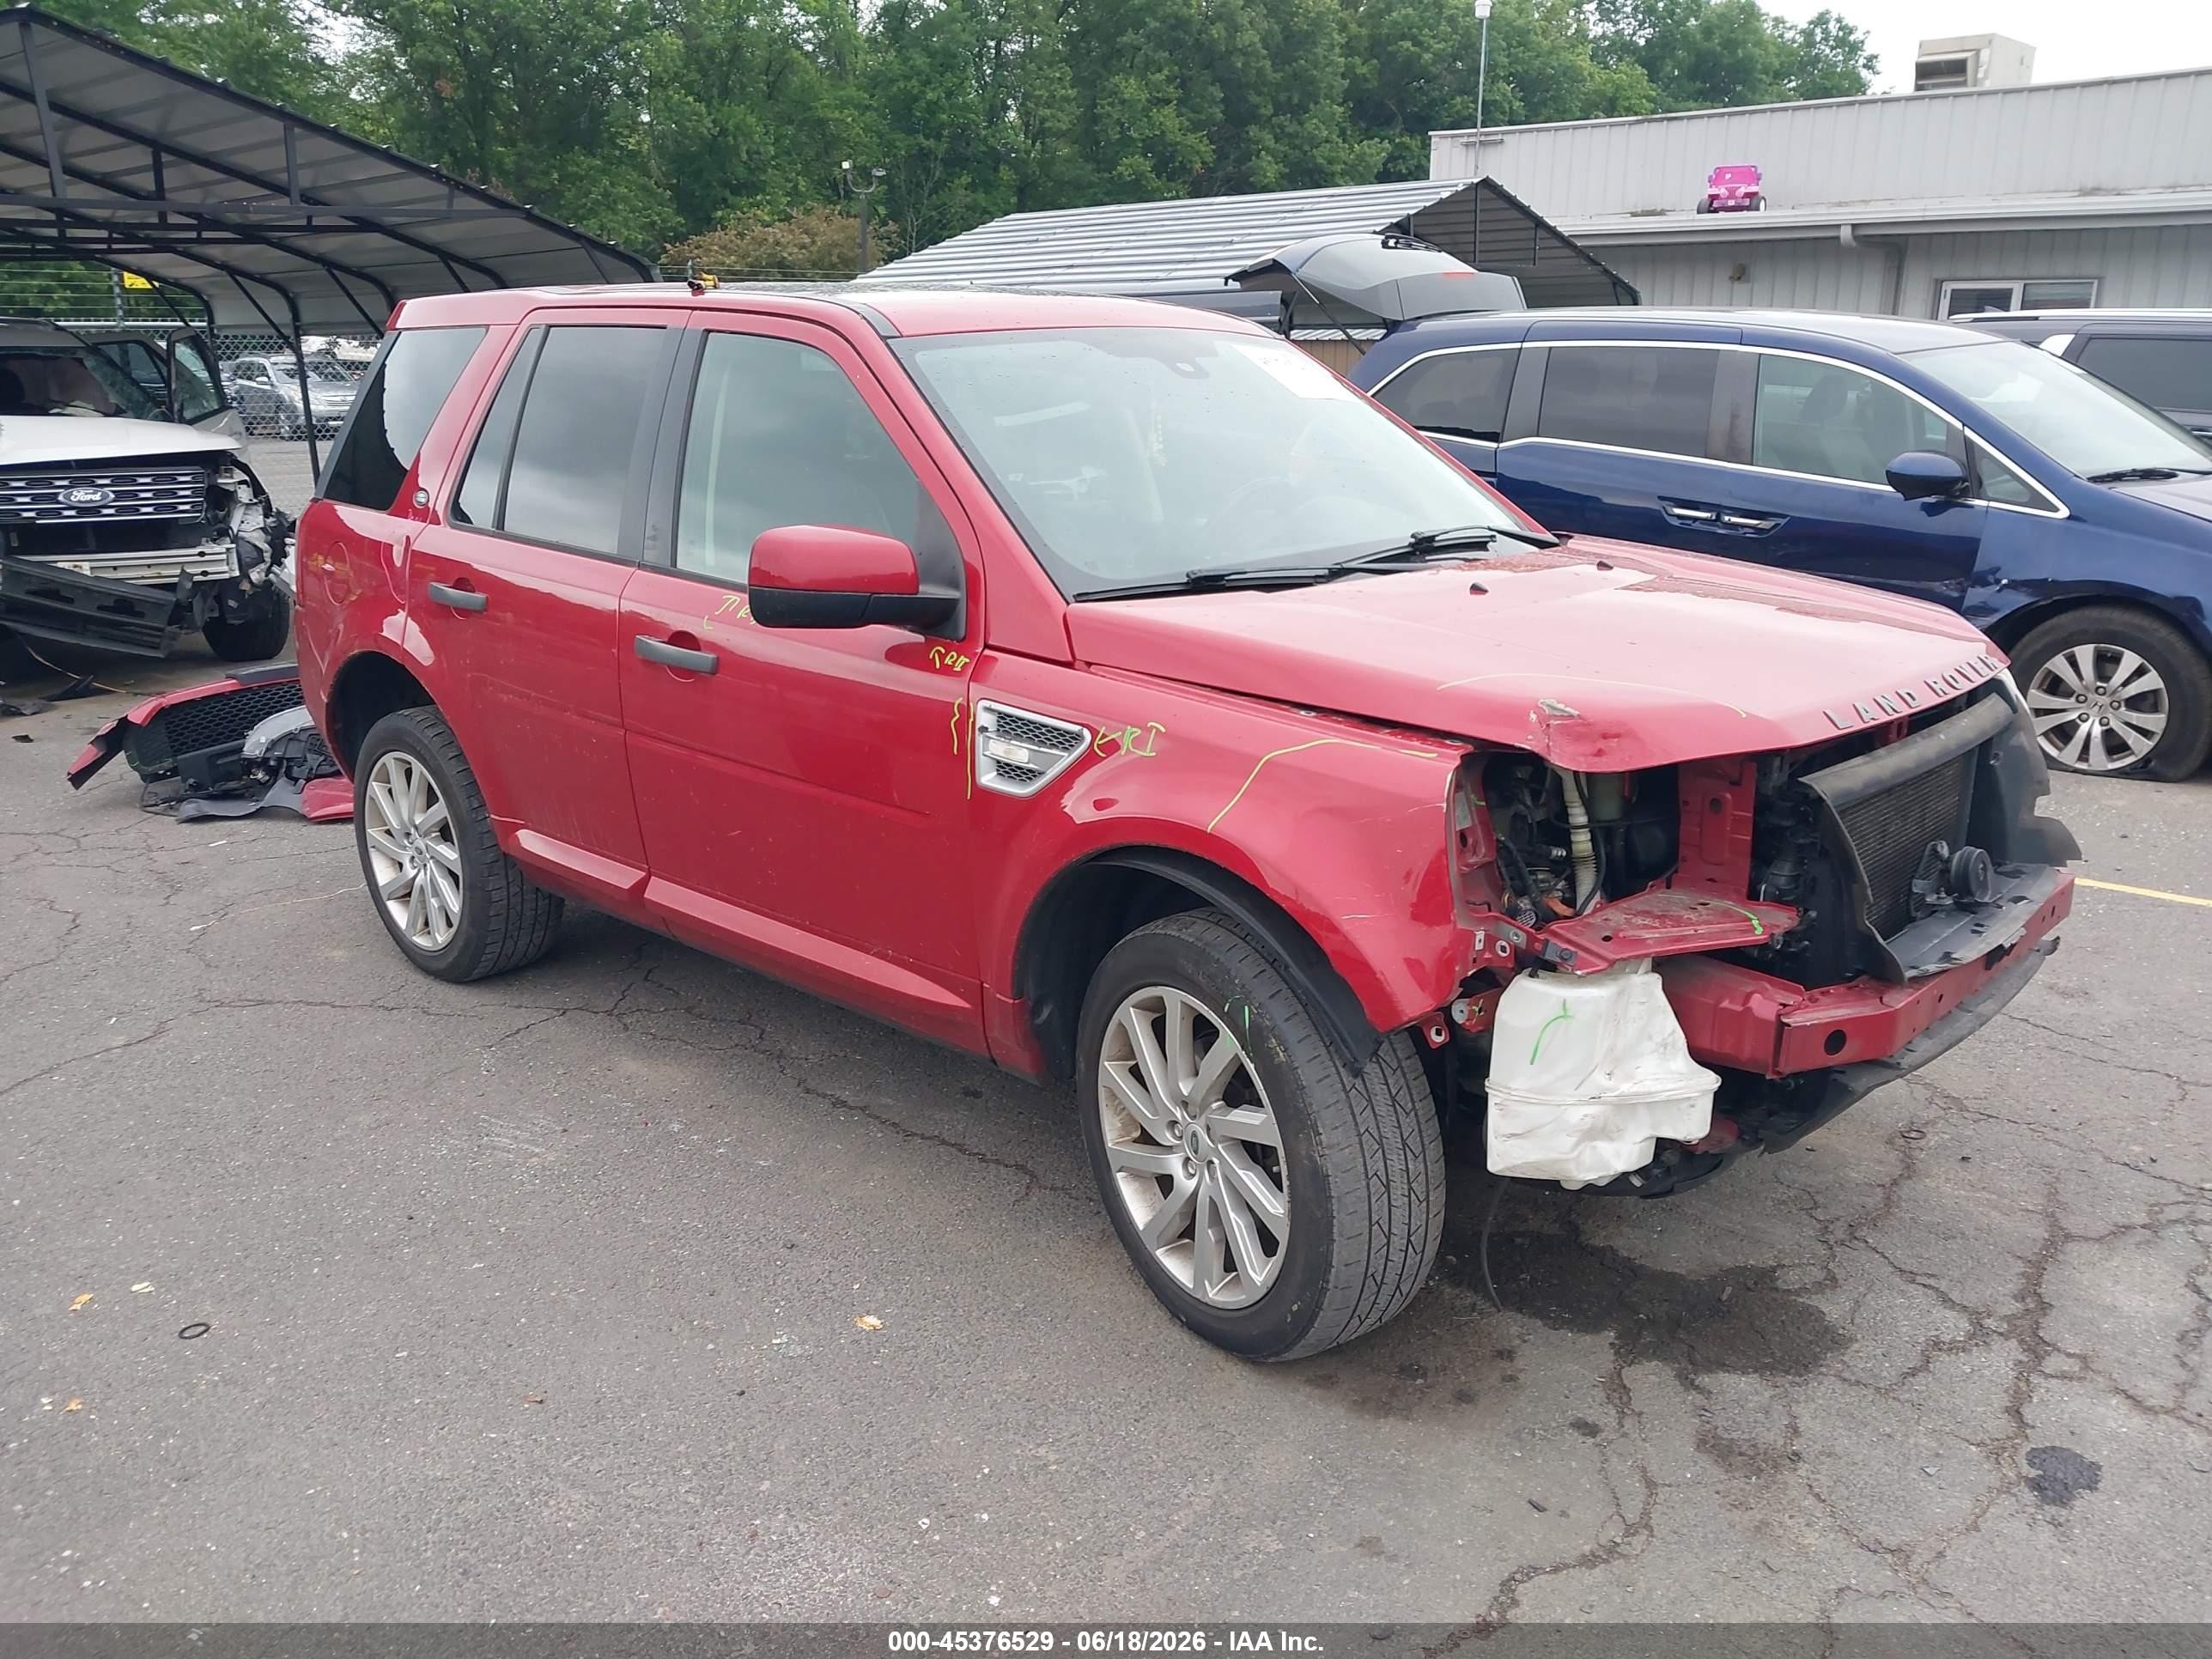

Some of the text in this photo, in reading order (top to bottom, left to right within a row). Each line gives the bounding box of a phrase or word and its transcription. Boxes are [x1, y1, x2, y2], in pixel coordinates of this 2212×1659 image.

[70, 489, 102, 501] Ford
[1822, 653, 1999, 730] LAND ROVER
